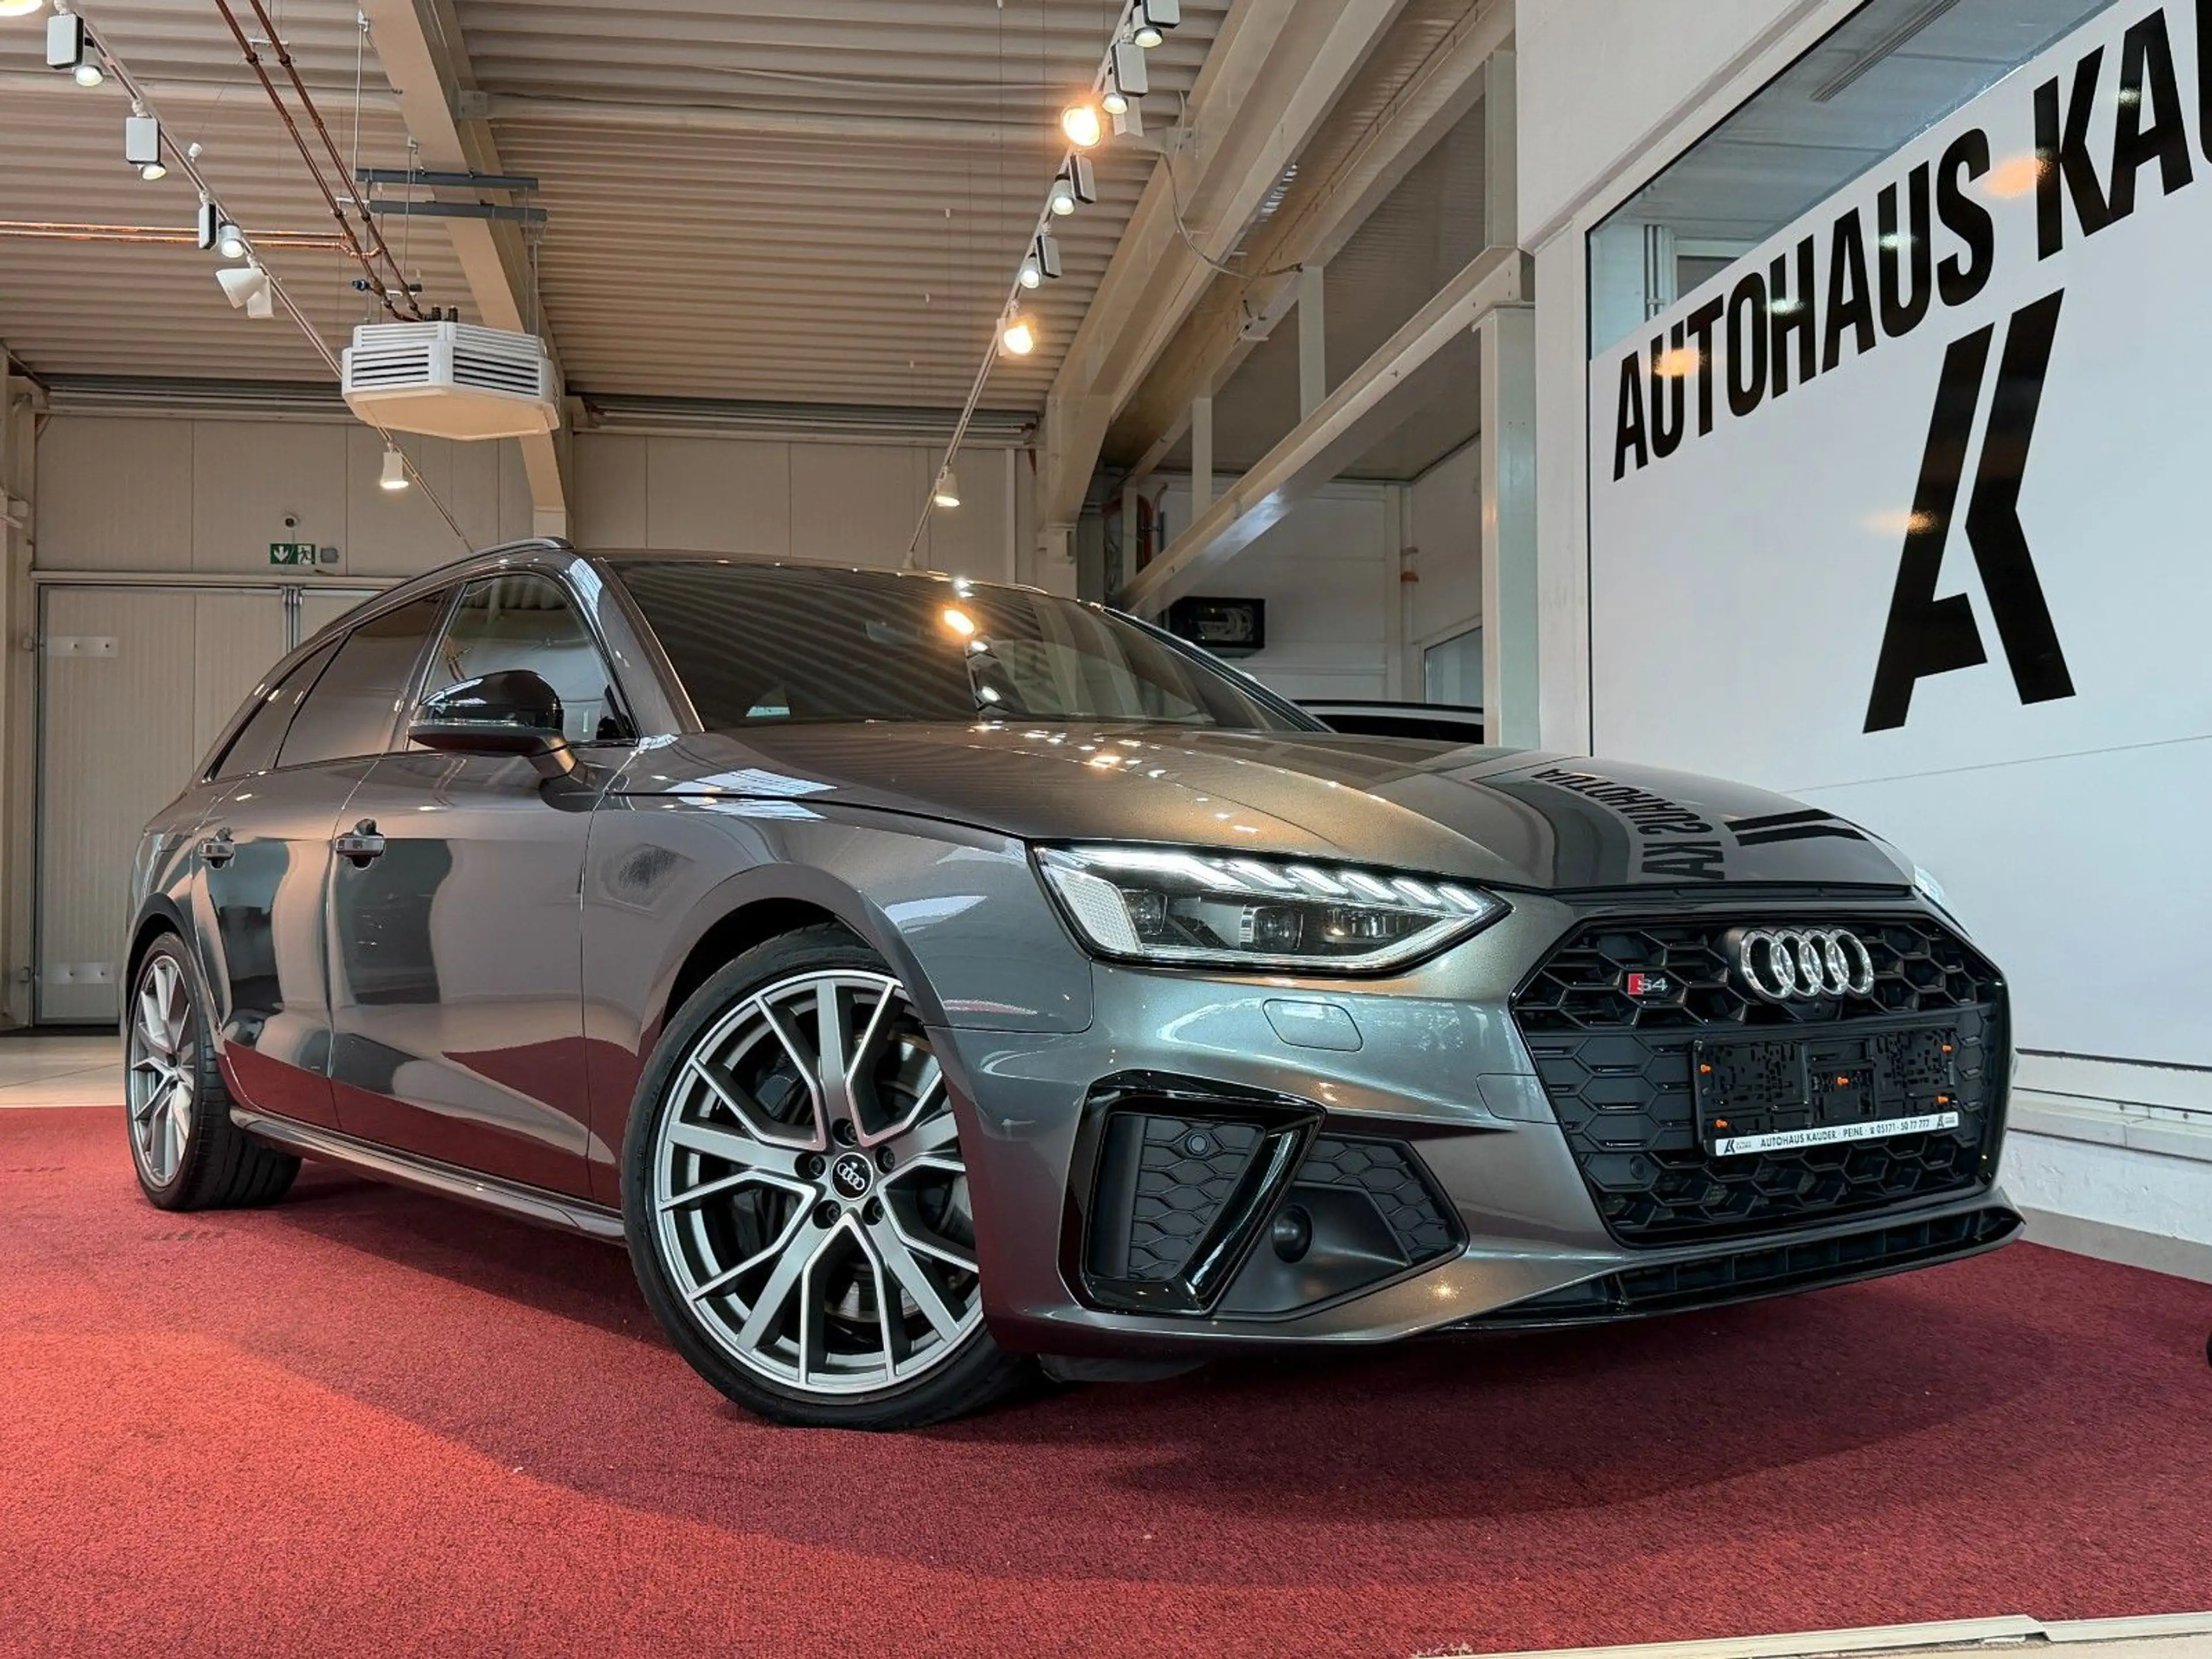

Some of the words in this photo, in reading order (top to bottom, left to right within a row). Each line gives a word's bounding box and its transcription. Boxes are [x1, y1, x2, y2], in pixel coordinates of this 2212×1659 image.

[1613, 128, 1994, 483] AUTOHAUS
[1637, 977, 1668, 991] S4
[1760, 1134, 1805, 1147] AUTOHAUS
[1806, 1130, 1837, 1142] KAUDER
[1843, 1126, 1863, 1137] PEINE
